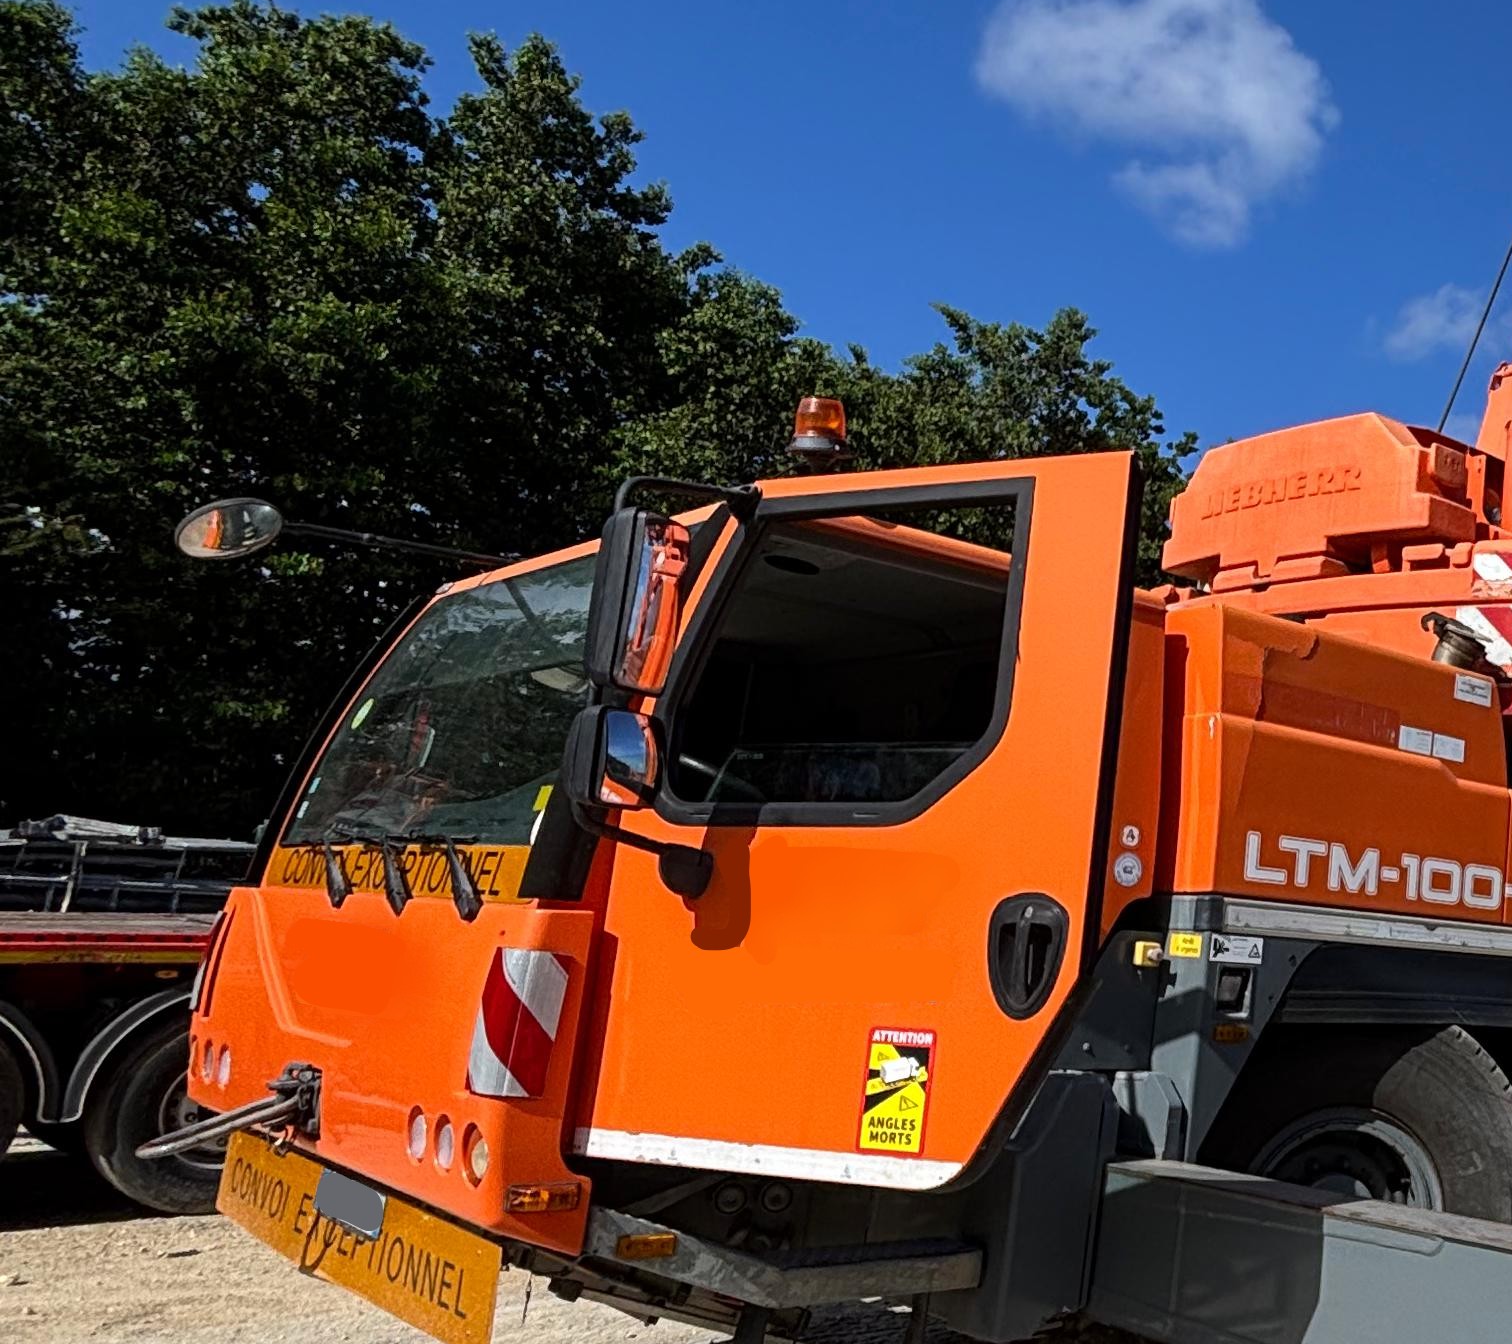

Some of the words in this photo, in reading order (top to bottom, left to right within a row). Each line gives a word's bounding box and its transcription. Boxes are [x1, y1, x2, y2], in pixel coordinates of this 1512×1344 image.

[282, 848, 350, 886] CONV
[351, 848, 505, 896] EXCPTIONEL
[872, 1029, 934, 1045] ATTENTION
[868, 1116, 916, 1131] ANGLES
[869, 1131, 912, 1146] MORTS
[230, 1157, 290, 1222] CONVOI
